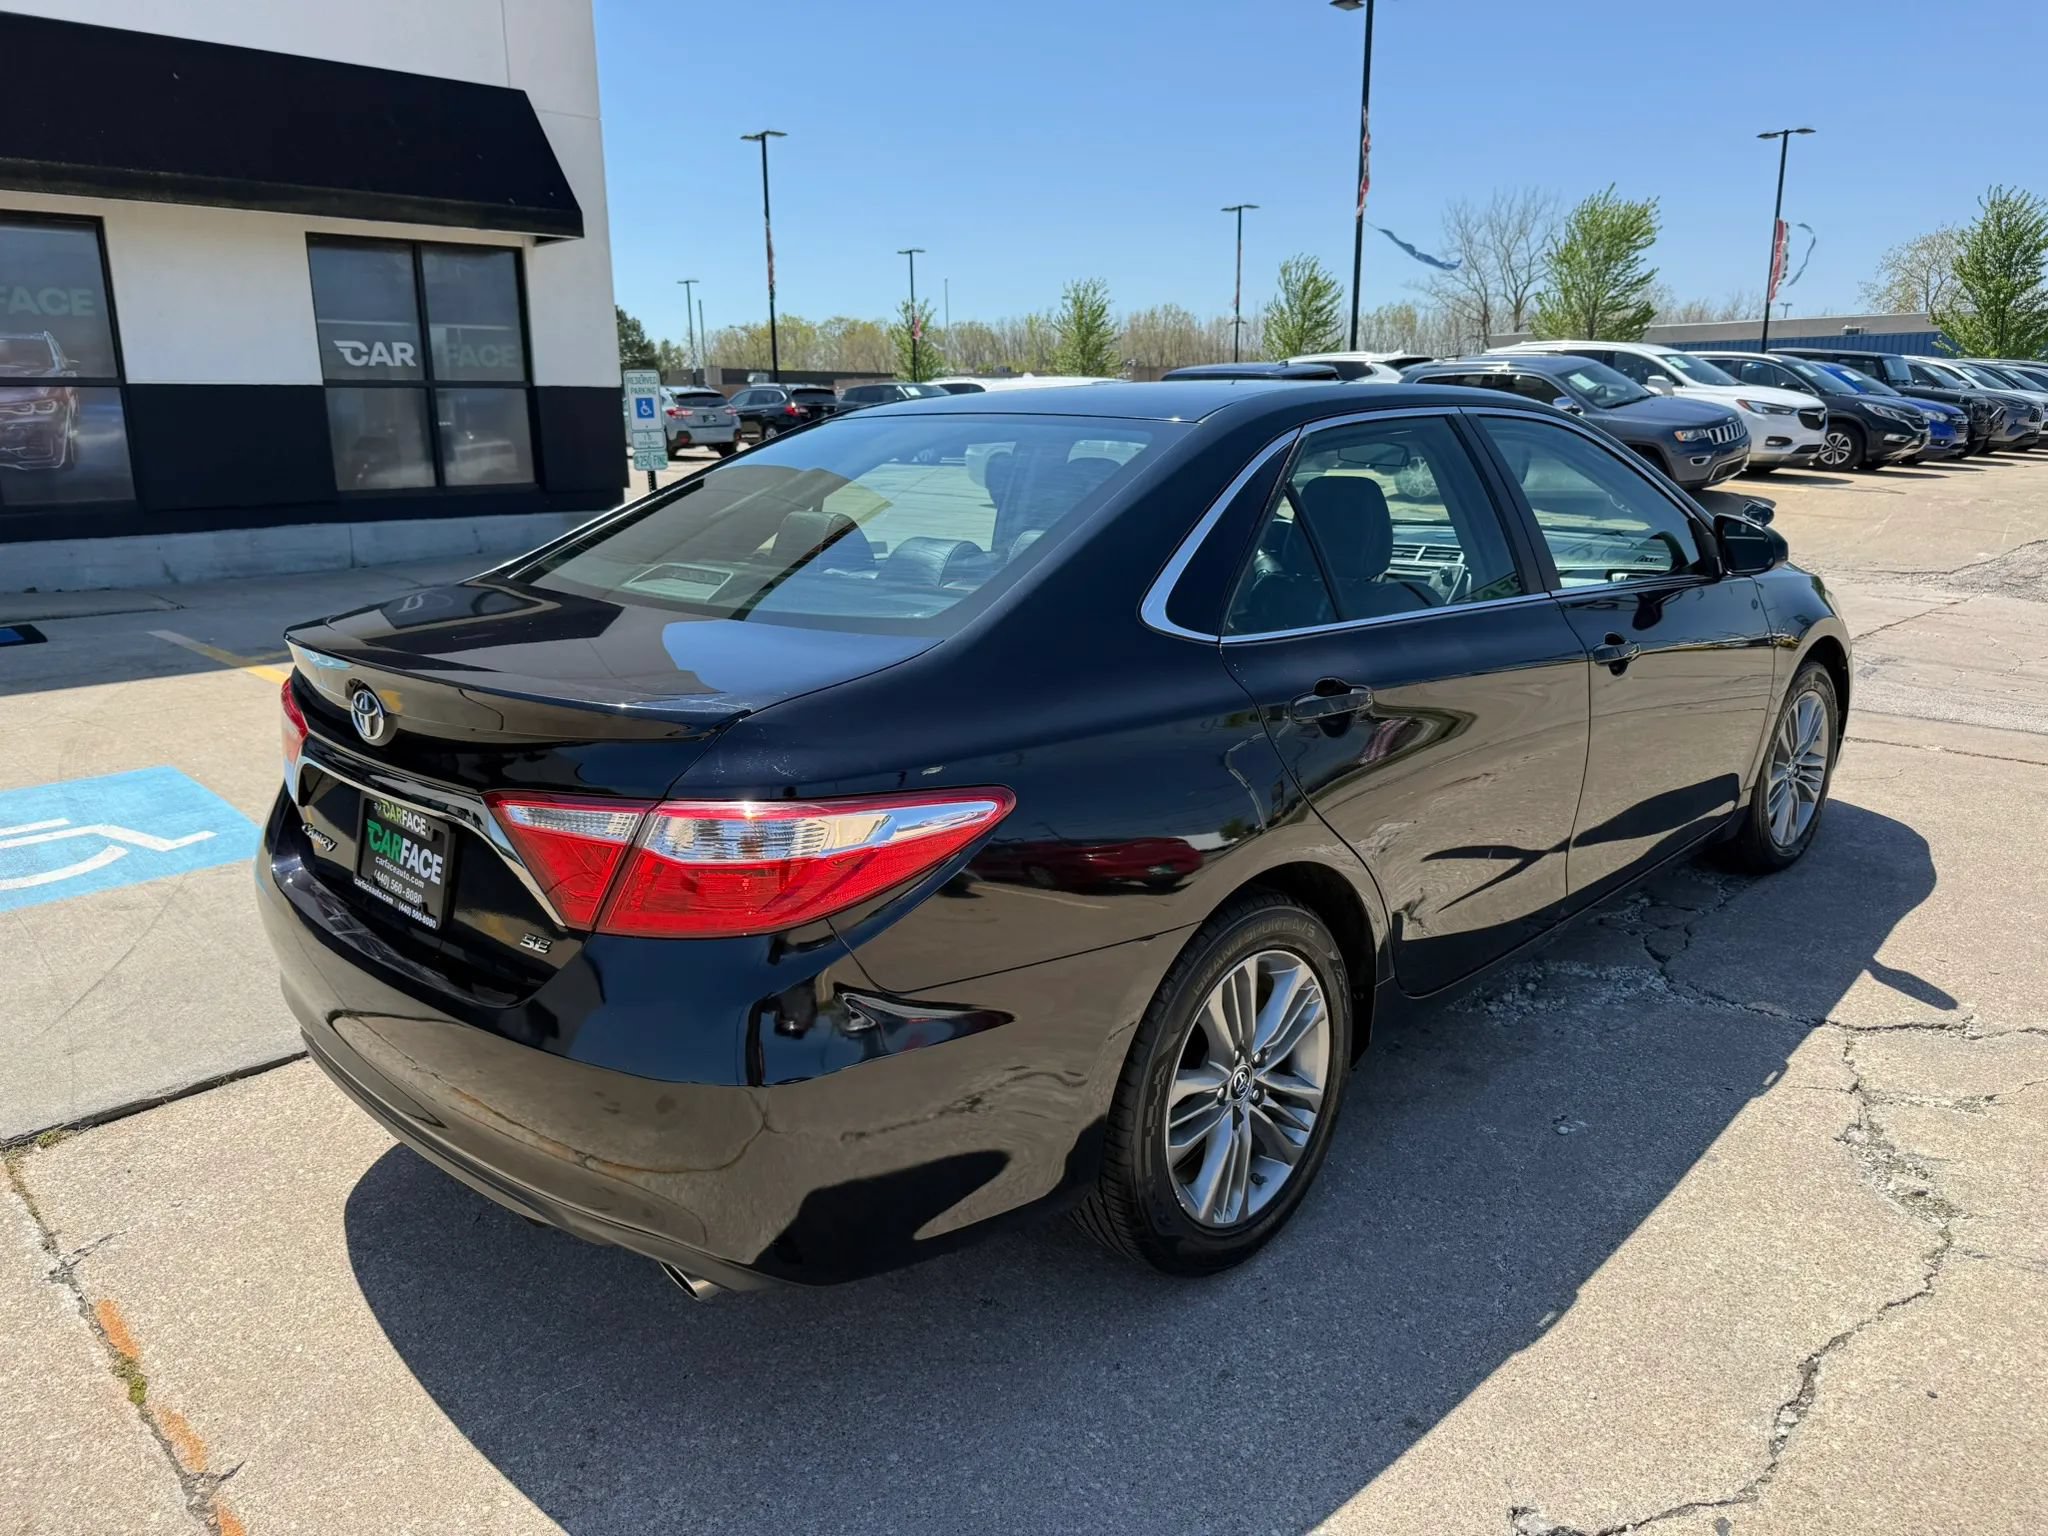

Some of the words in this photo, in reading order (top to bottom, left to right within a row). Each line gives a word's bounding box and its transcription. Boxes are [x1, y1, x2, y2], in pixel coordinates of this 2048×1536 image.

[334, 340, 416, 367] CAR
[446, 344, 517, 368] FACE
[630, 387, 657, 395] PARKING
[380, 799, 426, 836] CARFACE
[367, 818, 443, 885] CARFACE
[375, 856, 425, 889] carfaceauto.com
[354, 878, 394, 905] carfaceauto.com
[520, 933, 550, 954] SE
